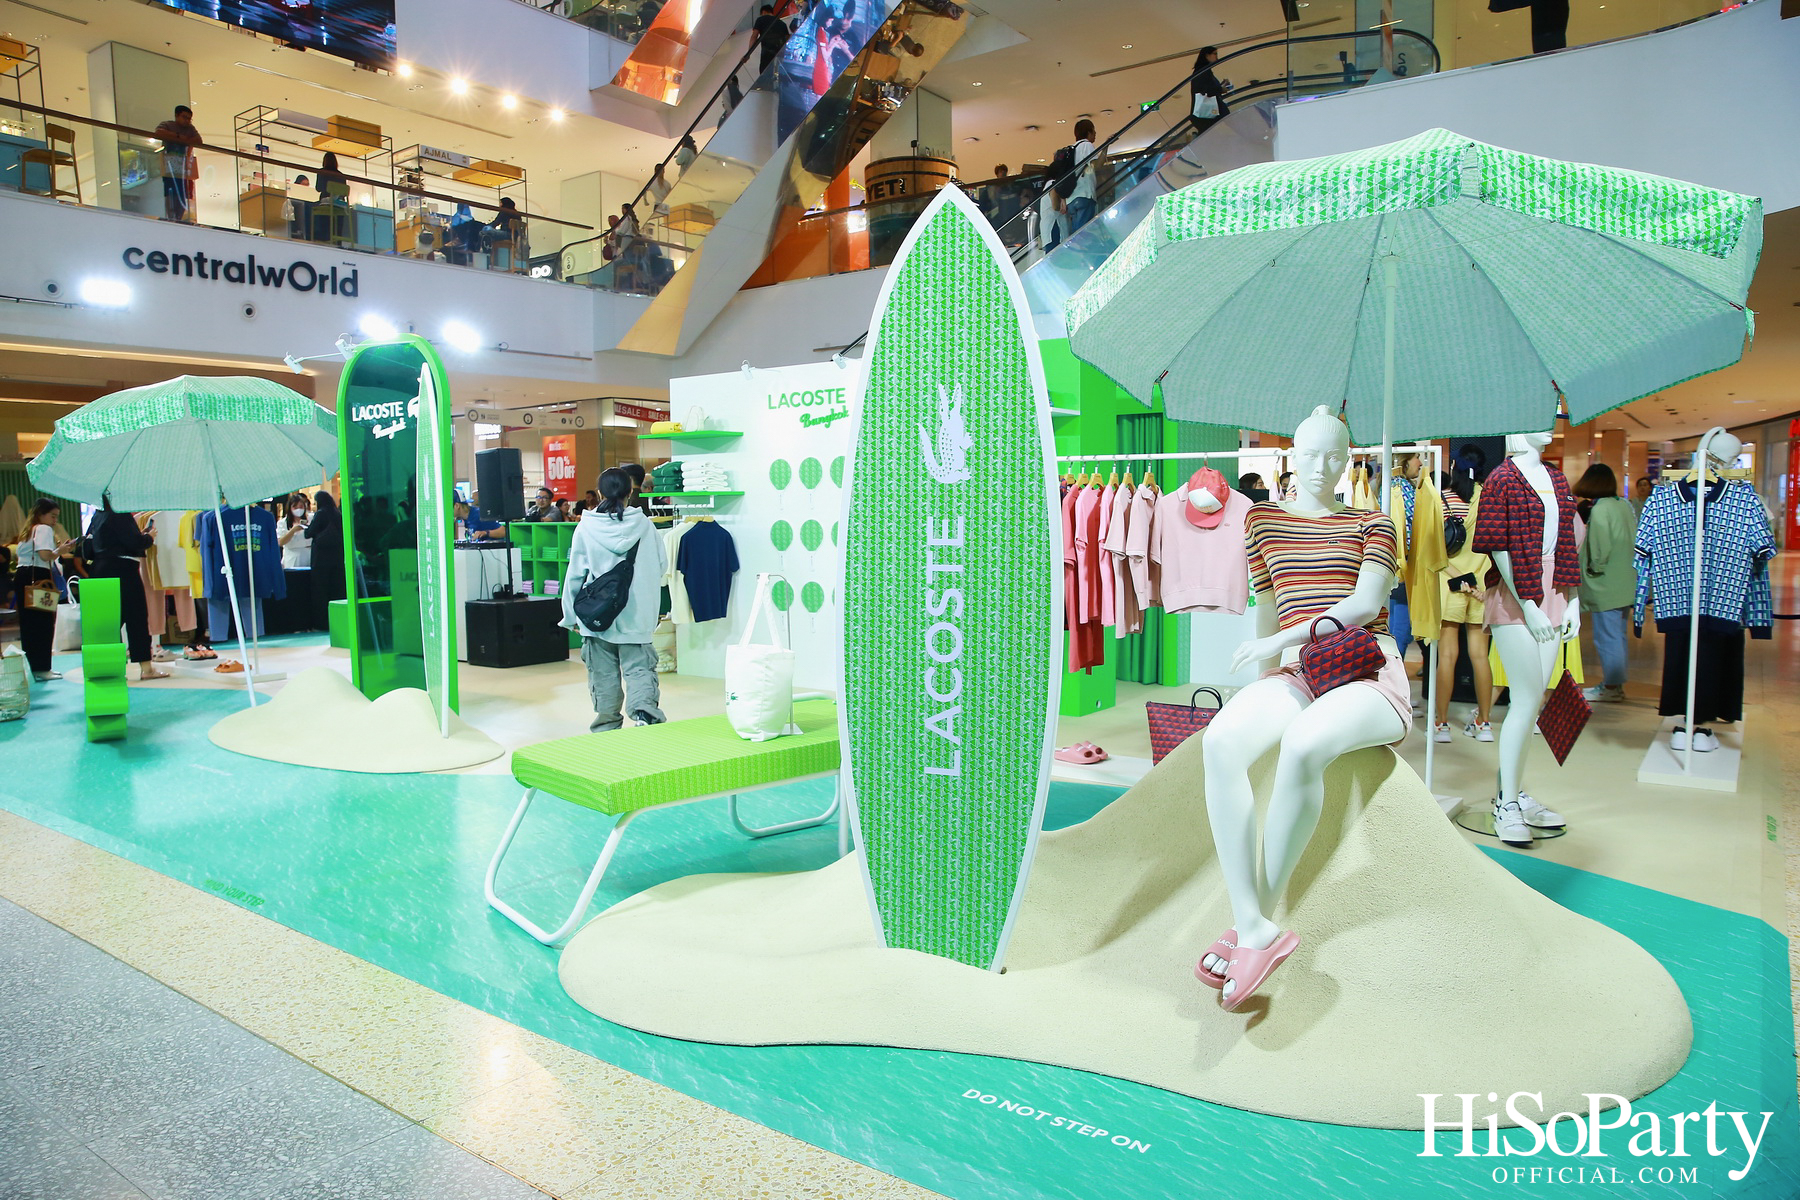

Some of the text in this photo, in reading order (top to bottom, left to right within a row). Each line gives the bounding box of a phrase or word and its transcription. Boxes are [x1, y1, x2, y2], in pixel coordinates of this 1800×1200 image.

[424, 147, 452, 161] AJMAL
[122, 246, 359, 297] centralwOrld
[768, 387, 846, 410] LACOSTE
[352, 401, 404, 422] LACOSTE
[799, 405, 849, 428] Bangkok
[424, 515, 435, 638] LACOSTE
[924, 515, 964, 777] LACOSTE
[222, 887, 246, 900] YOUR
[242, 894, 265, 907] STEP
[1217, 938, 1237, 949] LACO
[962, 1088, 1152, 1154] DO NOT STEP ON
